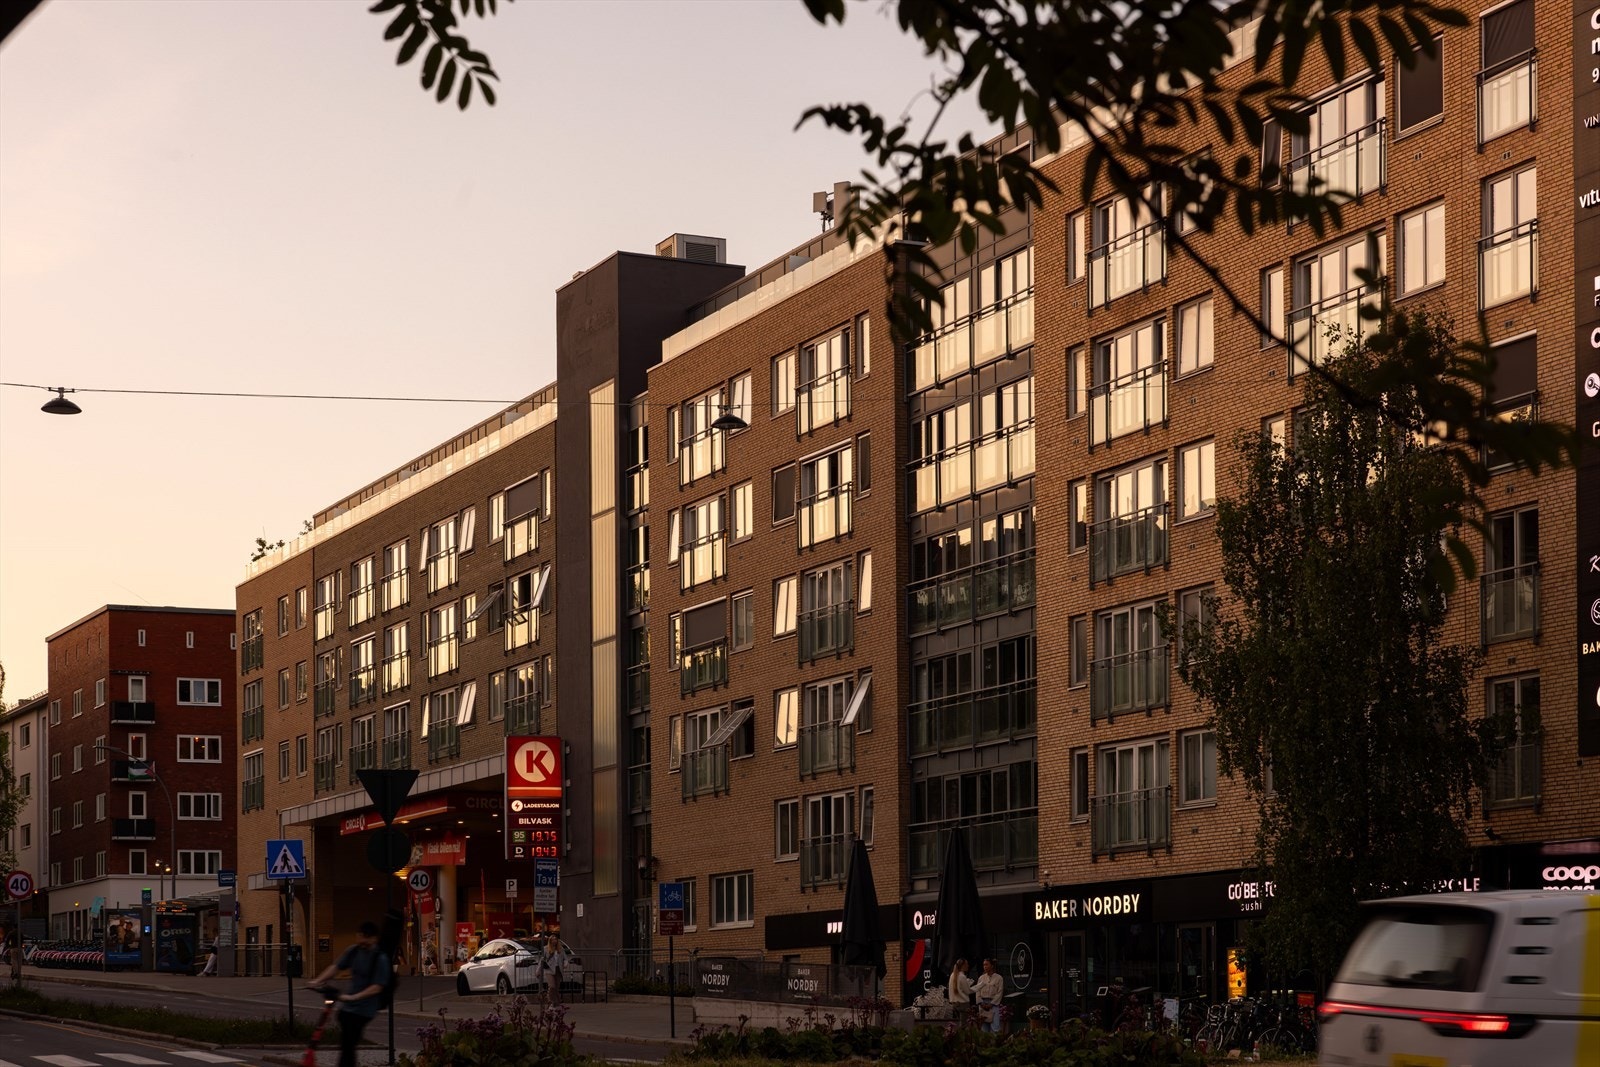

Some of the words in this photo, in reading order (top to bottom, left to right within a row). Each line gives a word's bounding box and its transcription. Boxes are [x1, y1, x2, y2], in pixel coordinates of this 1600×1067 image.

[1584, 113, 1600, 128] VIN
[1582, 641, 1600, 655] BAK
[465, 797, 504, 809] CIRCL
[518, 817, 552, 825] BILVASK
[514, 831, 525, 839] 95
[531, 831, 557, 841] 19.75
[515, 846, 524, 854] D
[531, 846, 557, 857] 19.43
[411, 874, 429, 887] 40
[536, 873, 556, 884] Taxi
[1542, 865, 1600, 884] coop
[10, 878, 29, 892] 40
[508, 880, 515, 890] P
[1035, 899, 1077, 920] BAKER
[1082, 893, 1140, 916] NORDBY
[1240, 900, 1263, 911] sushi
[702, 973, 730, 986] NORDBY
[787, 978, 819, 991] NORDBY
